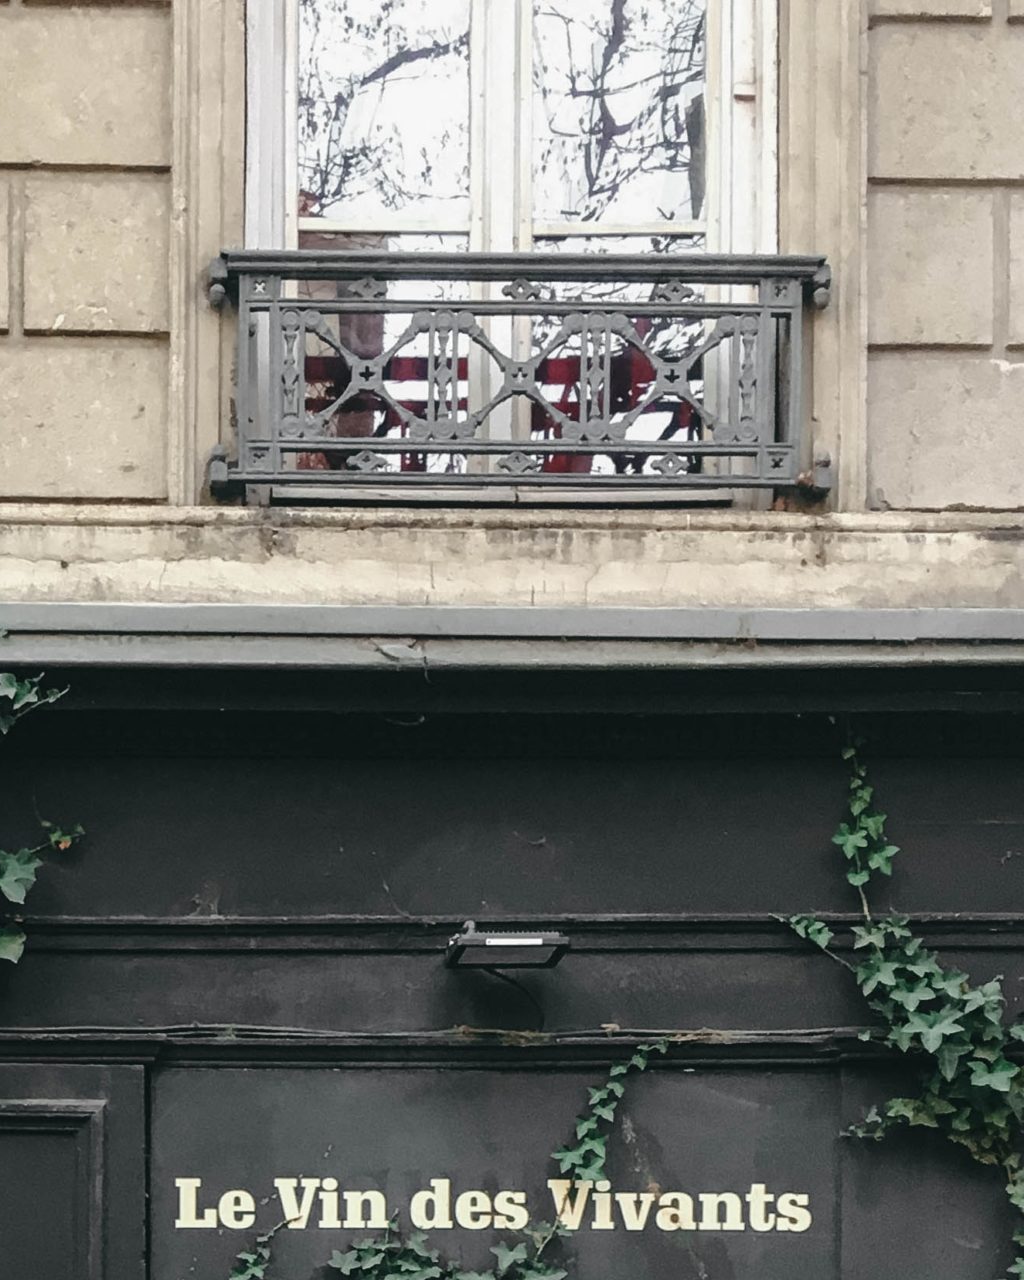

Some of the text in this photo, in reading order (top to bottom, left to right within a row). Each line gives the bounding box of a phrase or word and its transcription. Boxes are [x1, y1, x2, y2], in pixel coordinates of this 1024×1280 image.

[175, 1176, 812, 1233] Le Vin des Vivants
